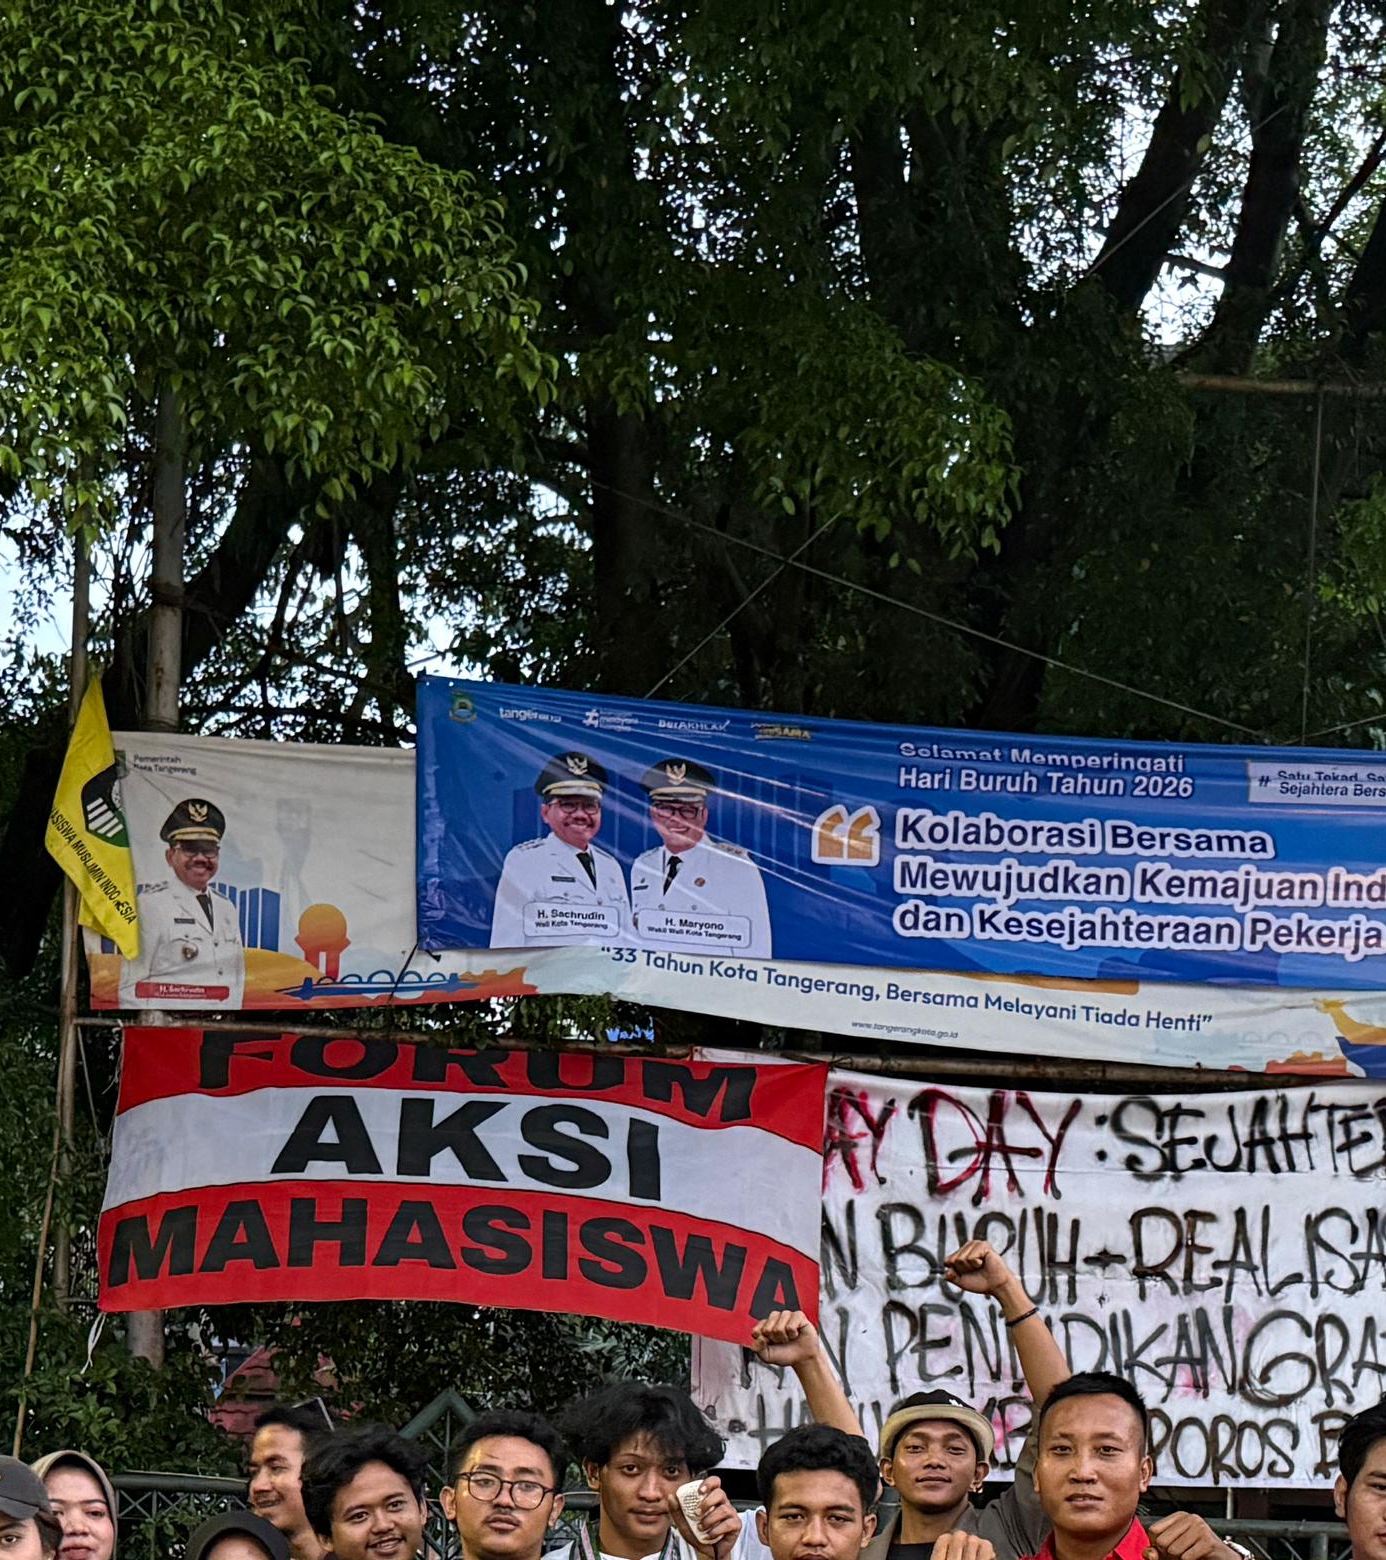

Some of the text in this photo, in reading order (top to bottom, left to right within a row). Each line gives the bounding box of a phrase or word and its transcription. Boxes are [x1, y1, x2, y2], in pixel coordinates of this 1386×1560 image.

[899, 742, 1184, 773] Selamat Memperingati
[899, 767, 1193, 798] Hari Buruh Tahun 2026
[901, 813, 1268, 854] Kolaborasi Bersama
[899, 861, 1125, 900] Mewujudkan
[1139, 868, 1319, 906] Kemajuan
[537, 909, 605, 921] H. Sachrudin
[665, 918, 725, 932] H. Maryono
[899, 903, 1383, 956] dan Kesejahteraan Pekerja
[642, 949, 703, 976] Tahun
[710, 960, 758, 982] Kota
[763, 967, 881, 1002] Tangerang,
[887, 983, 979, 1009] Bersama
[984, 993, 1077, 1021] Melayani
[1080, 1005, 1141, 1028] Tiada
[198, 1029, 757, 1123] FORUM
[270, 1094, 661, 1201] AKSI
[821, 1086, 898, 1197] AY
[907, 1087, 1083, 1207] DAY
[107, 1198, 804, 1320] MAHASISWA
[1145, 1406, 1300, 1486] POROS
